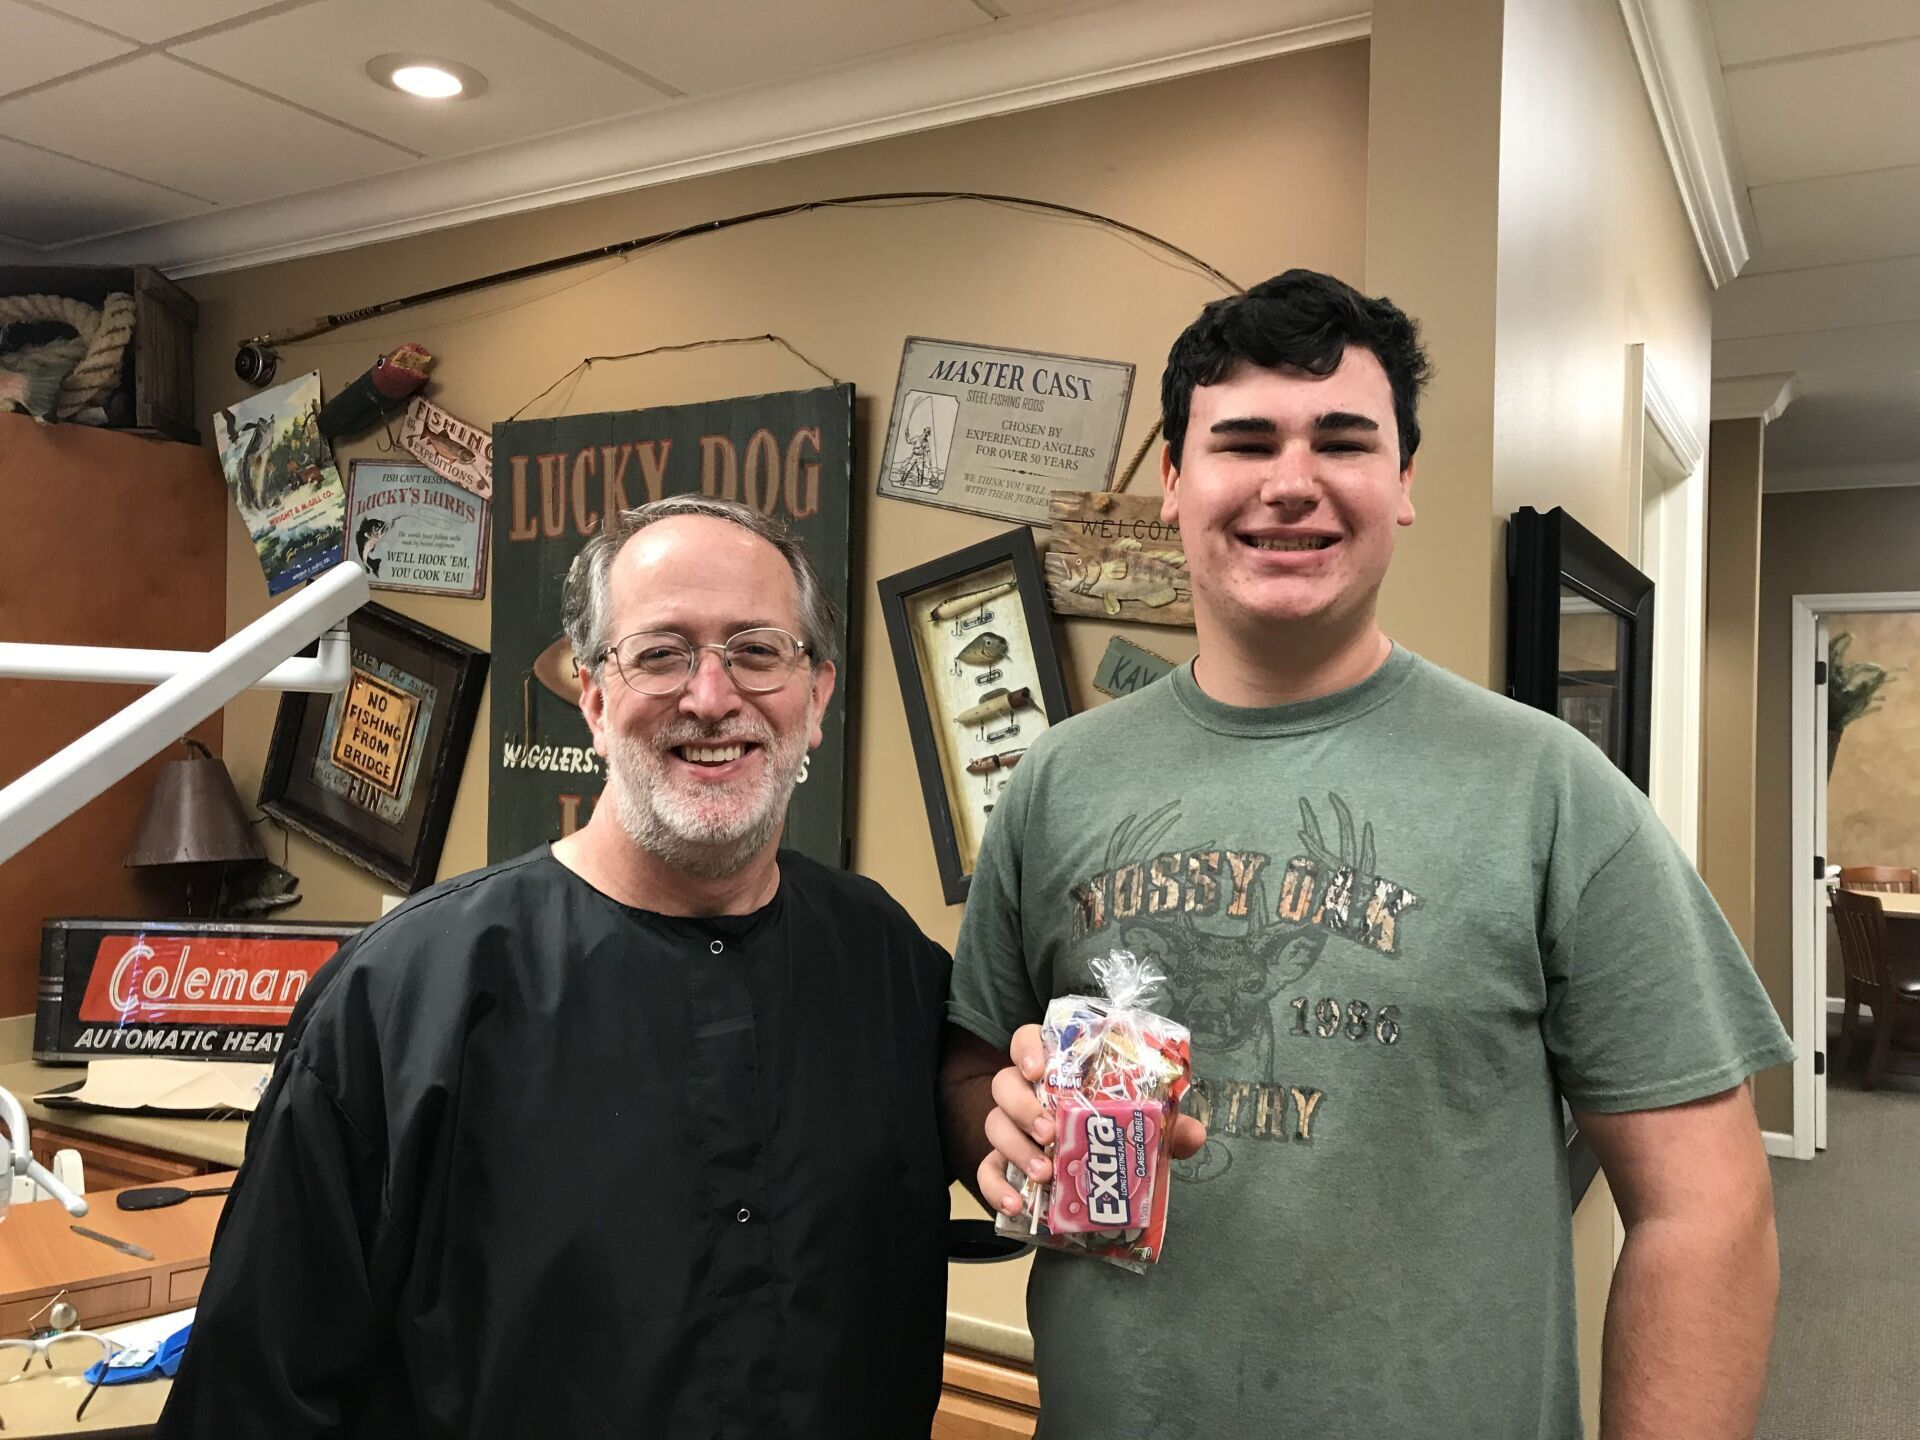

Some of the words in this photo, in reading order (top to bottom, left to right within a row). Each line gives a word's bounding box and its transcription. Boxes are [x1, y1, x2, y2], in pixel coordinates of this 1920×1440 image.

[928, 360, 1025, 392] MASTER
[1032, 369, 1093, 401] CAST
[966, 389, 988, 405] STEEL
[990, 393, 1020, 409] FISHING
[1021, 398, 1045, 413] RODS
[966, 428, 1041, 450] EXPERIENCED
[1042, 441, 1096, 458] ANGLERS
[1001, 419, 1046, 435] CHOSEN
[1048, 426, 1063, 438] BY
[414, 442, 474, 485] EXPEDITIONS
[975, 444, 997, 457] FOR
[998, 448, 1028, 463] OVER
[1030, 453, 1041, 465] 50
[1043, 455, 1079, 471] YEARS
[508, 437, 673, 543] LUCKY
[699, 426, 822, 520] DOG
[356, 487, 420, 516] LUCKY'S
[423, 489, 476, 523] LURES
[387, 550, 416, 564] WE'LL
[417, 553, 447, 567] HOOK
[391, 566, 411, 579] YOU
[413, 568, 441, 581] COOK
[443, 570, 465, 583] 'EM!
[367, 691, 388, 713] NO
[349, 704, 402, 740] FISHING
[352, 727, 389, 757] FROM
[503, 742, 600, 774] WIGGLERS,
[344, 743, 391, 780] BRIDGE
[347, 775, 383, 813] FUN
[1070, 848, 1270, 944] MOSSY
[1277, 854, 1422, 954] OAK
[108, 944, 308, 1012] Coleman
[1289, 996, 1399, 1045] 1986
[74, 1028, 219, 1051] AUTOMATIC
[1133, 1111, 1143, 1143] BUBBLE
[1087, 1116, 1128, 1224] Extra
[1135, 1144, 1146, 1177] CLASSIC
[1120, 1179, 1128, 1197] LONG
